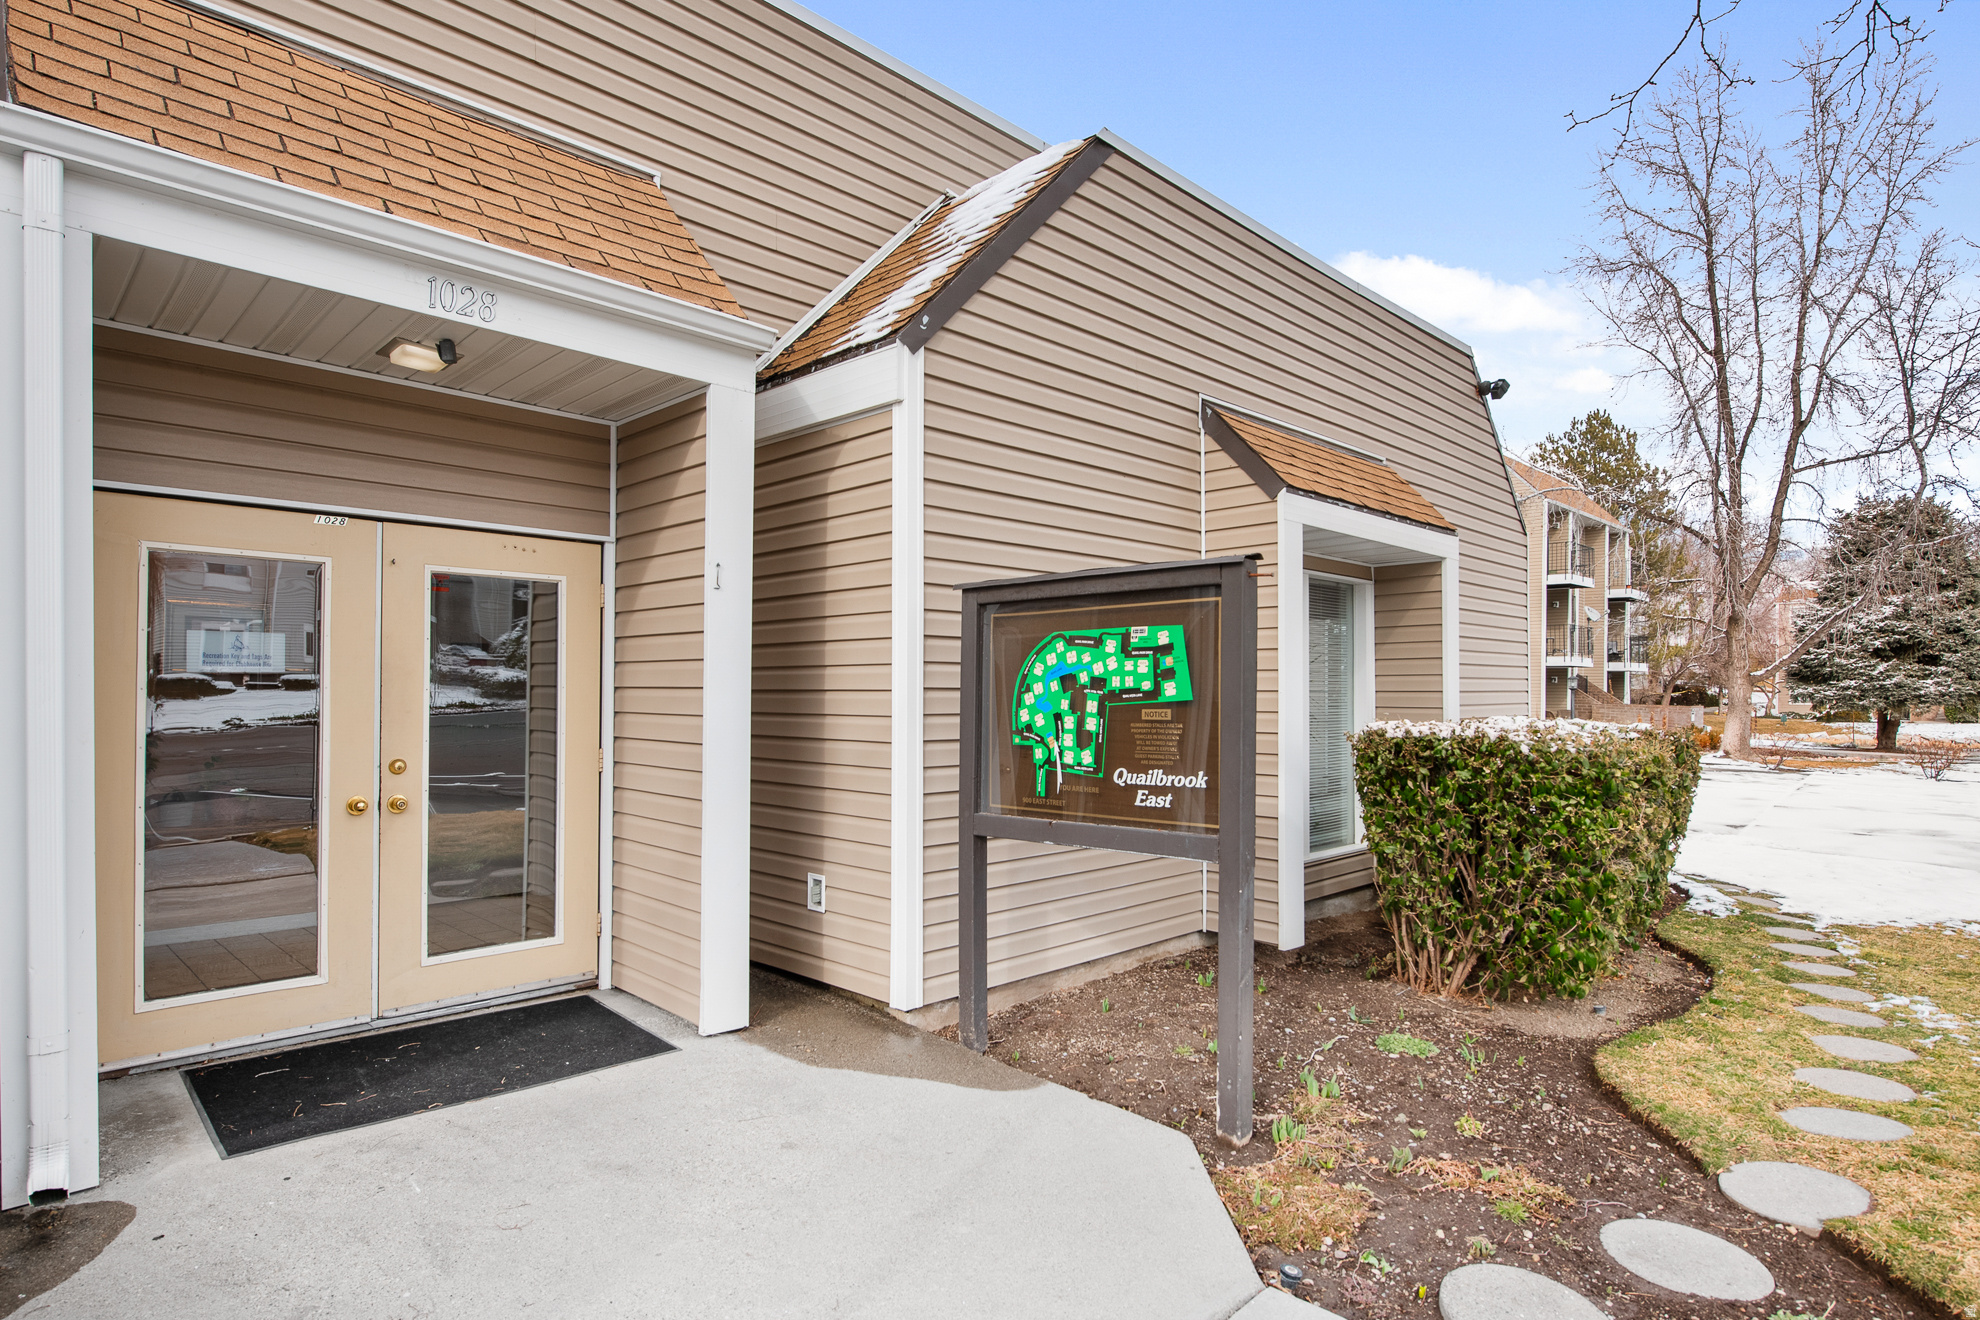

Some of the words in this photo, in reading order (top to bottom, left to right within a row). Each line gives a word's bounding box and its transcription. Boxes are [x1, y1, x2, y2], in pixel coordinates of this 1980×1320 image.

[427, 276, 498, 323] 1028
[317, 515, 347, 526] 1028
[202, 651, 230, 659] Recreation
[230, 653, 240, 661] Key
[202, 660, 226, 668] Required
[1113, 767, 1208, 788] Quailbrook
[1071, 785, 1083, 793] ARE
[1084, 786, 1099, 794] HERE
[1046, 799, 1066, 807] STREET
[1134, 789, 1173, 808] East
